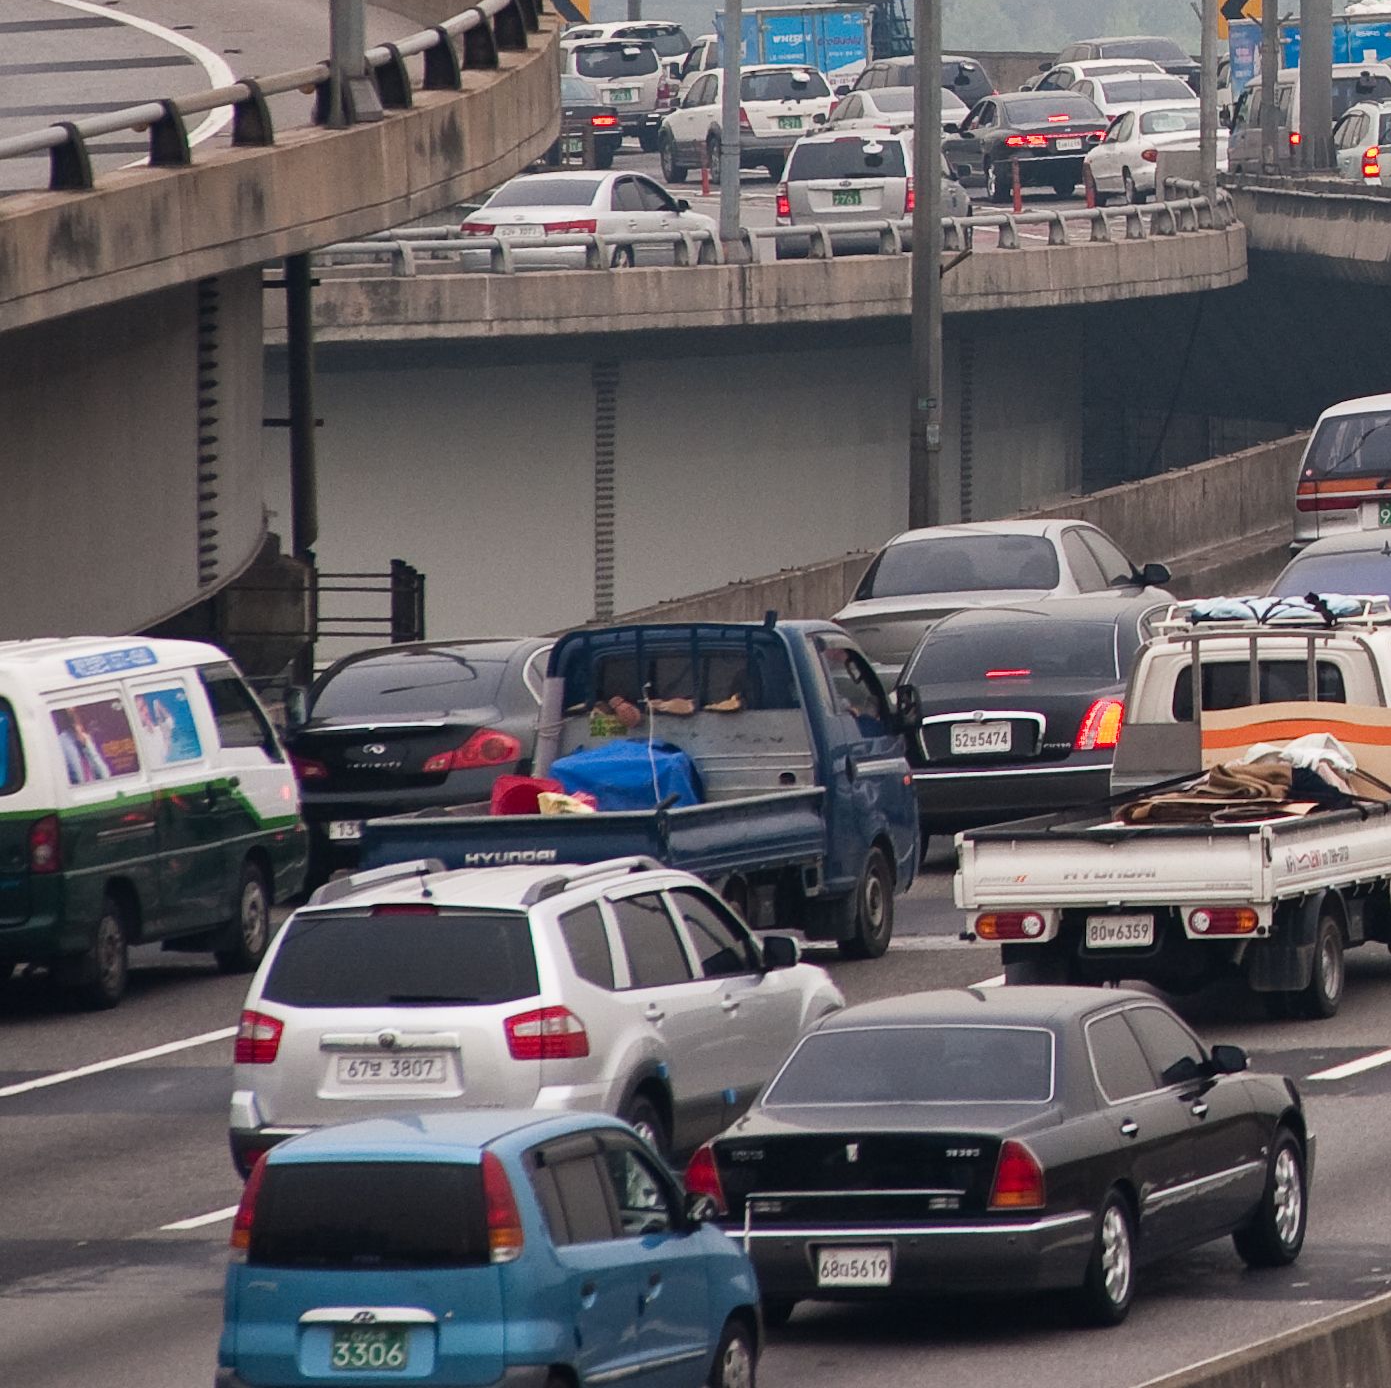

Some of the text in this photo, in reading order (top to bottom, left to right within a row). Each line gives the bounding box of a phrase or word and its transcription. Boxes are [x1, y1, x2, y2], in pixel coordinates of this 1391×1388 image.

[465, 849, 557, 864] HYUNDAI
[389, 1059, 435, 1077] 3807
[332, 1342, 403, 1367] 3306
